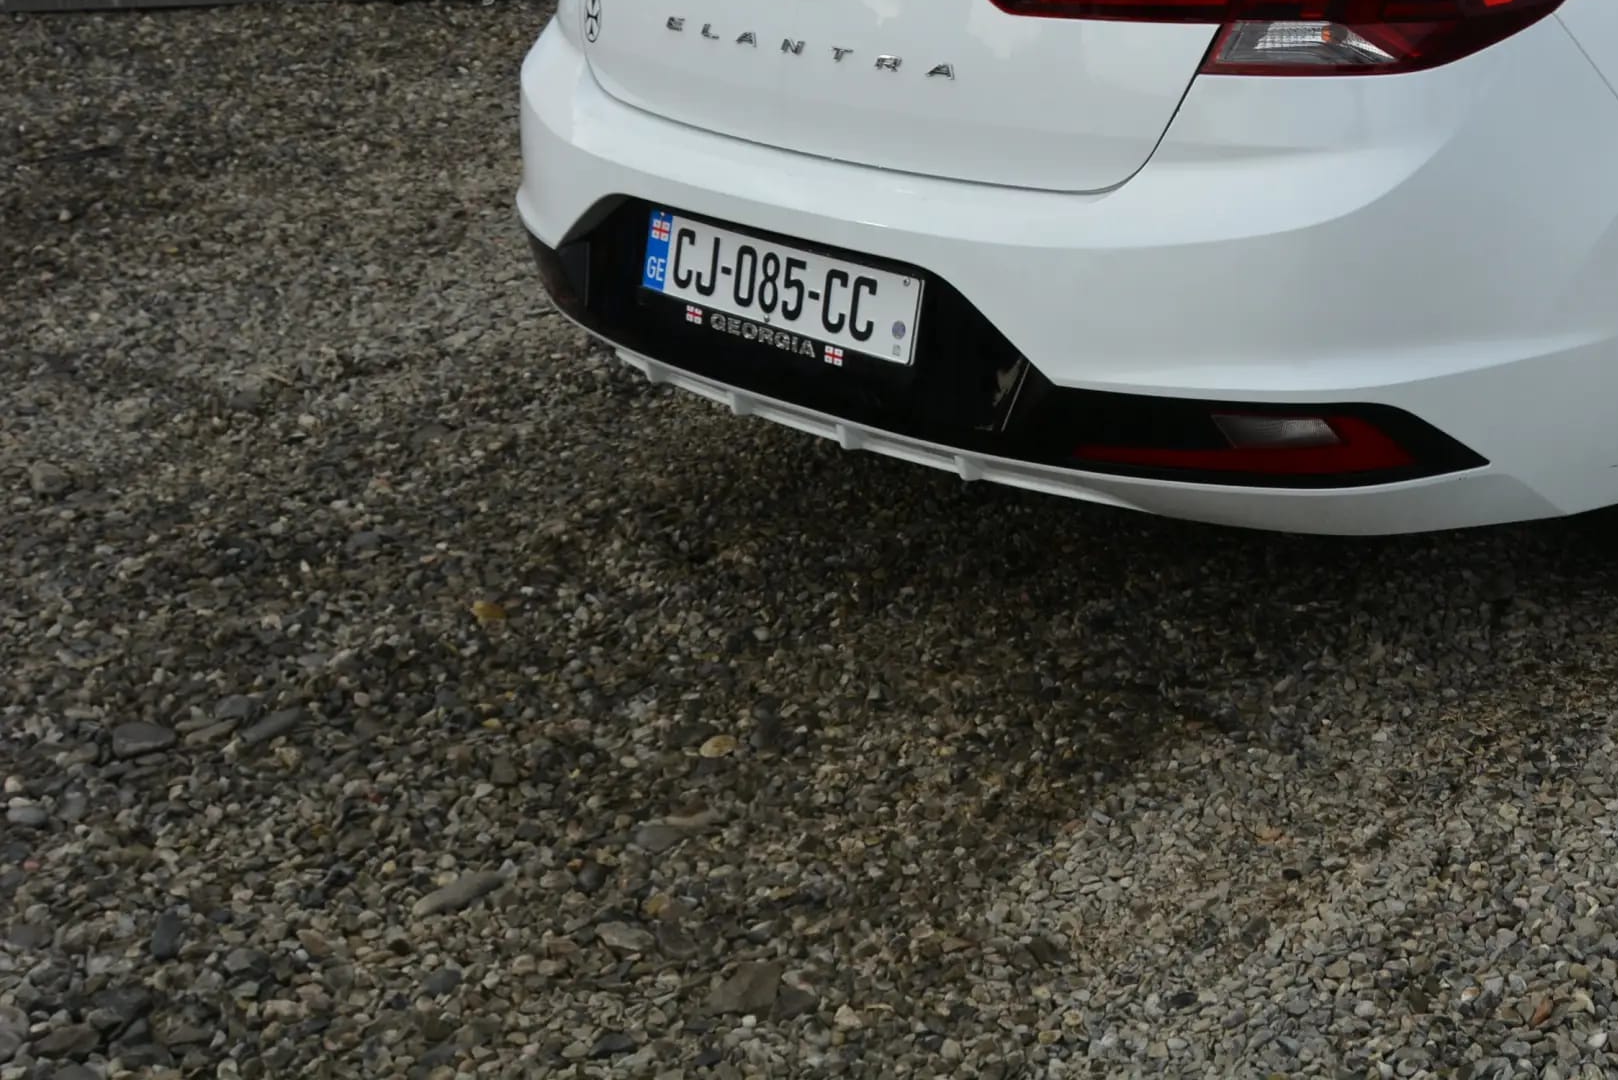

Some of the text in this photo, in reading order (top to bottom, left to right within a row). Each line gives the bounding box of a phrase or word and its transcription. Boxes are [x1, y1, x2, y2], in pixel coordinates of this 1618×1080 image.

[666, 15, 956, 81] ELANTRA
[646, 255, 667, 282] GE
[673, 227, 878, 342] CJ-085-CC
[710, 313, 816, 358] GEORGIA
